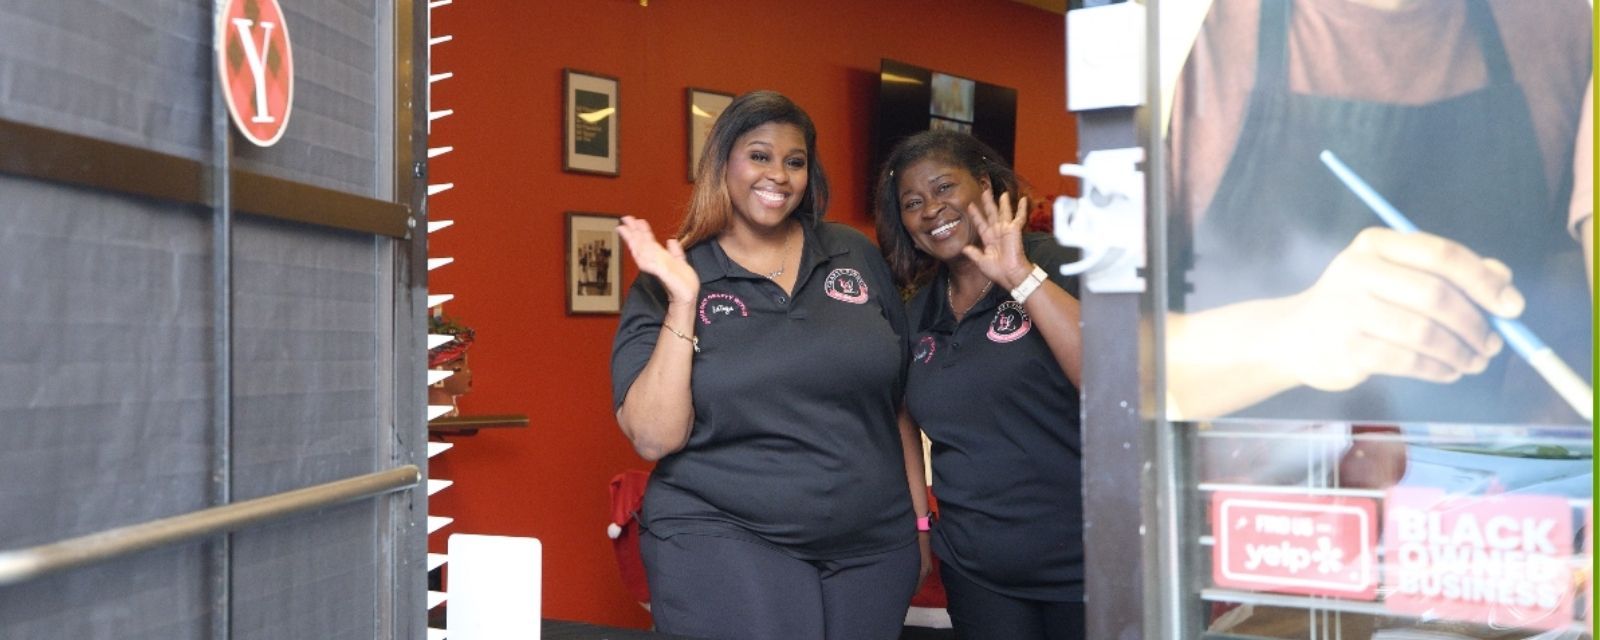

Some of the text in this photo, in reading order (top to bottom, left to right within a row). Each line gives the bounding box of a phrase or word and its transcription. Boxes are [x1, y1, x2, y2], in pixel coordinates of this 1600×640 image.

[232, 18, 275, 123] Y
[1400, 511, 1557, 553] BLACK
[1245, 541, 1311, 574] yelp
[1400, 544, 1559, 583] OWNED
[1400, 573, 1558, 608] BUSINESS
